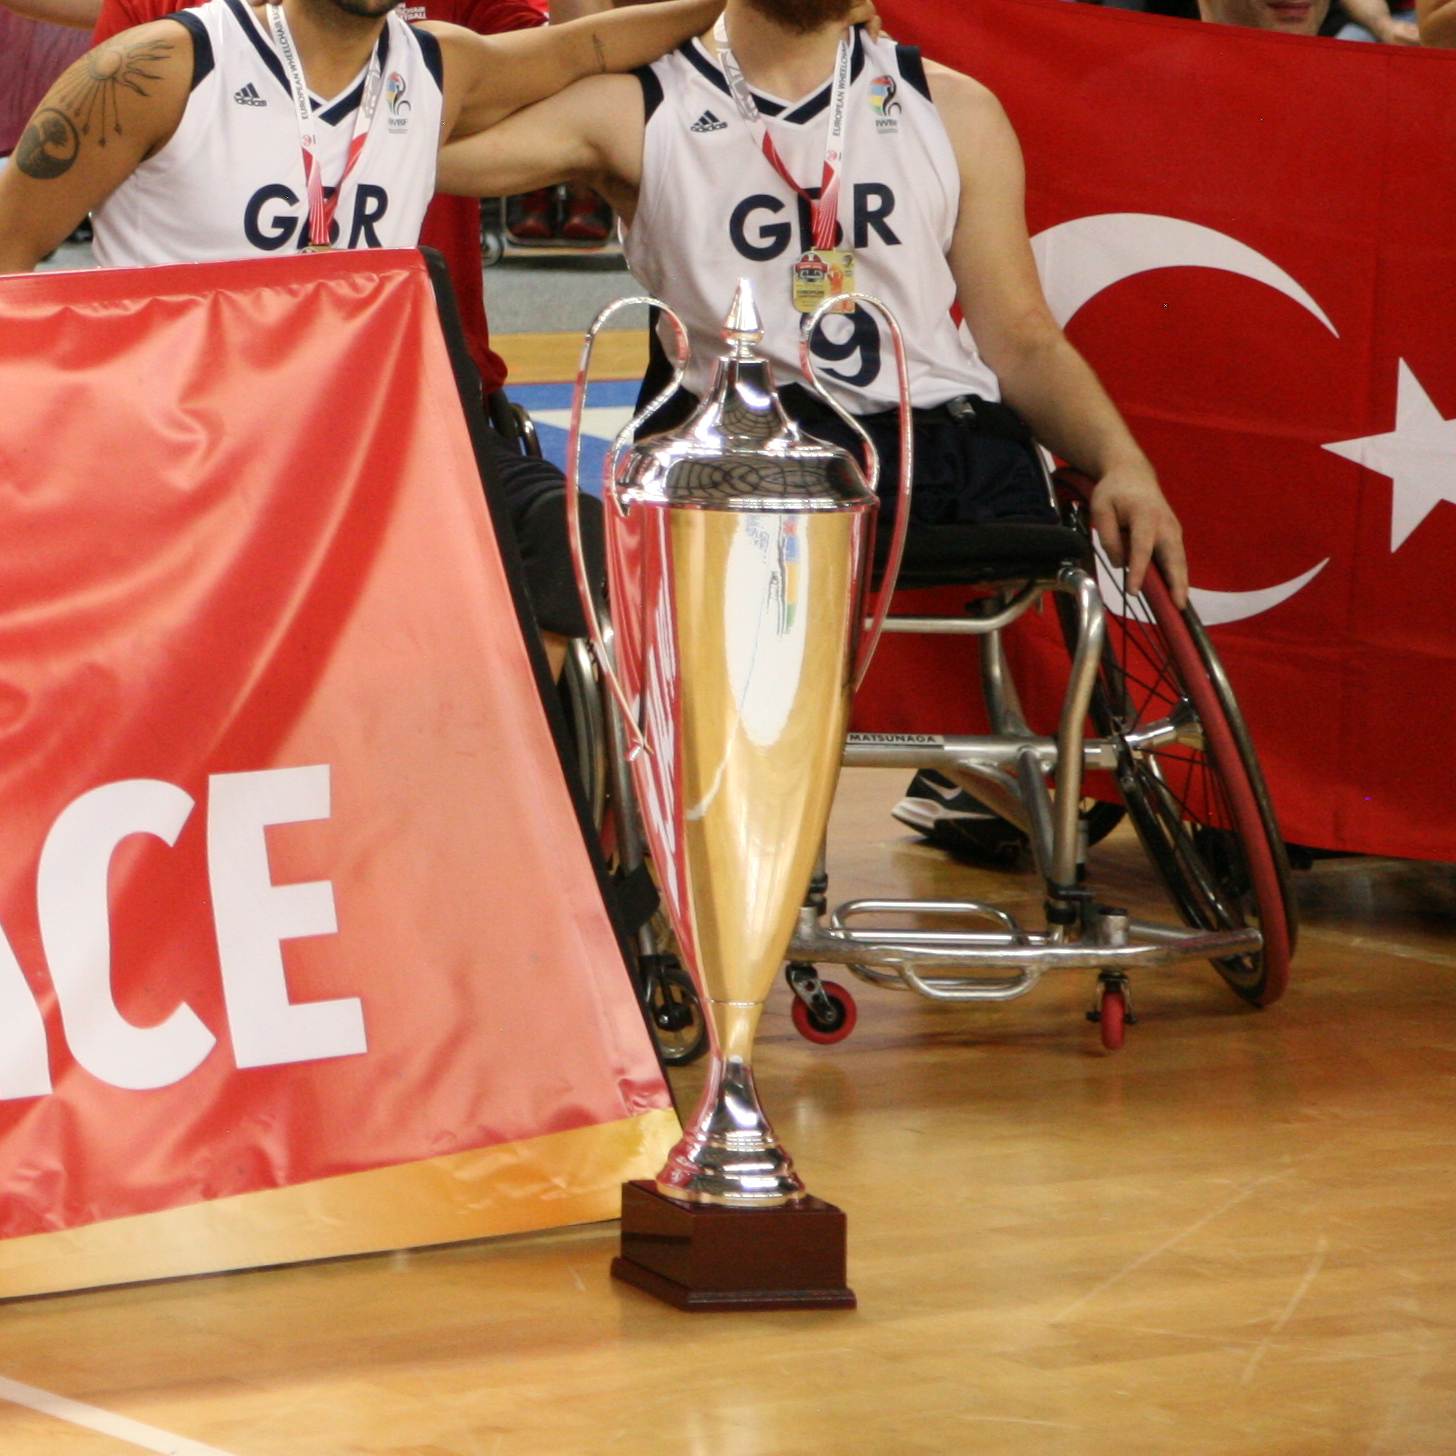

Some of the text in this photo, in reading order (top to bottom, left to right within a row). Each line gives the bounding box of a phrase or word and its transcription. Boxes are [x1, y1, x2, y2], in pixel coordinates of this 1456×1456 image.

[274, 22, 296, 71] WHEELCHAIR
[291, 70, 310, 121] EUROPEAN
[830, 90, 844, 137] EUROPEAN
[689, 121, 728, 134] adidas
[799, 301, 881, 388] 9
[849, 733, 937, 744] MATSUNAGA
